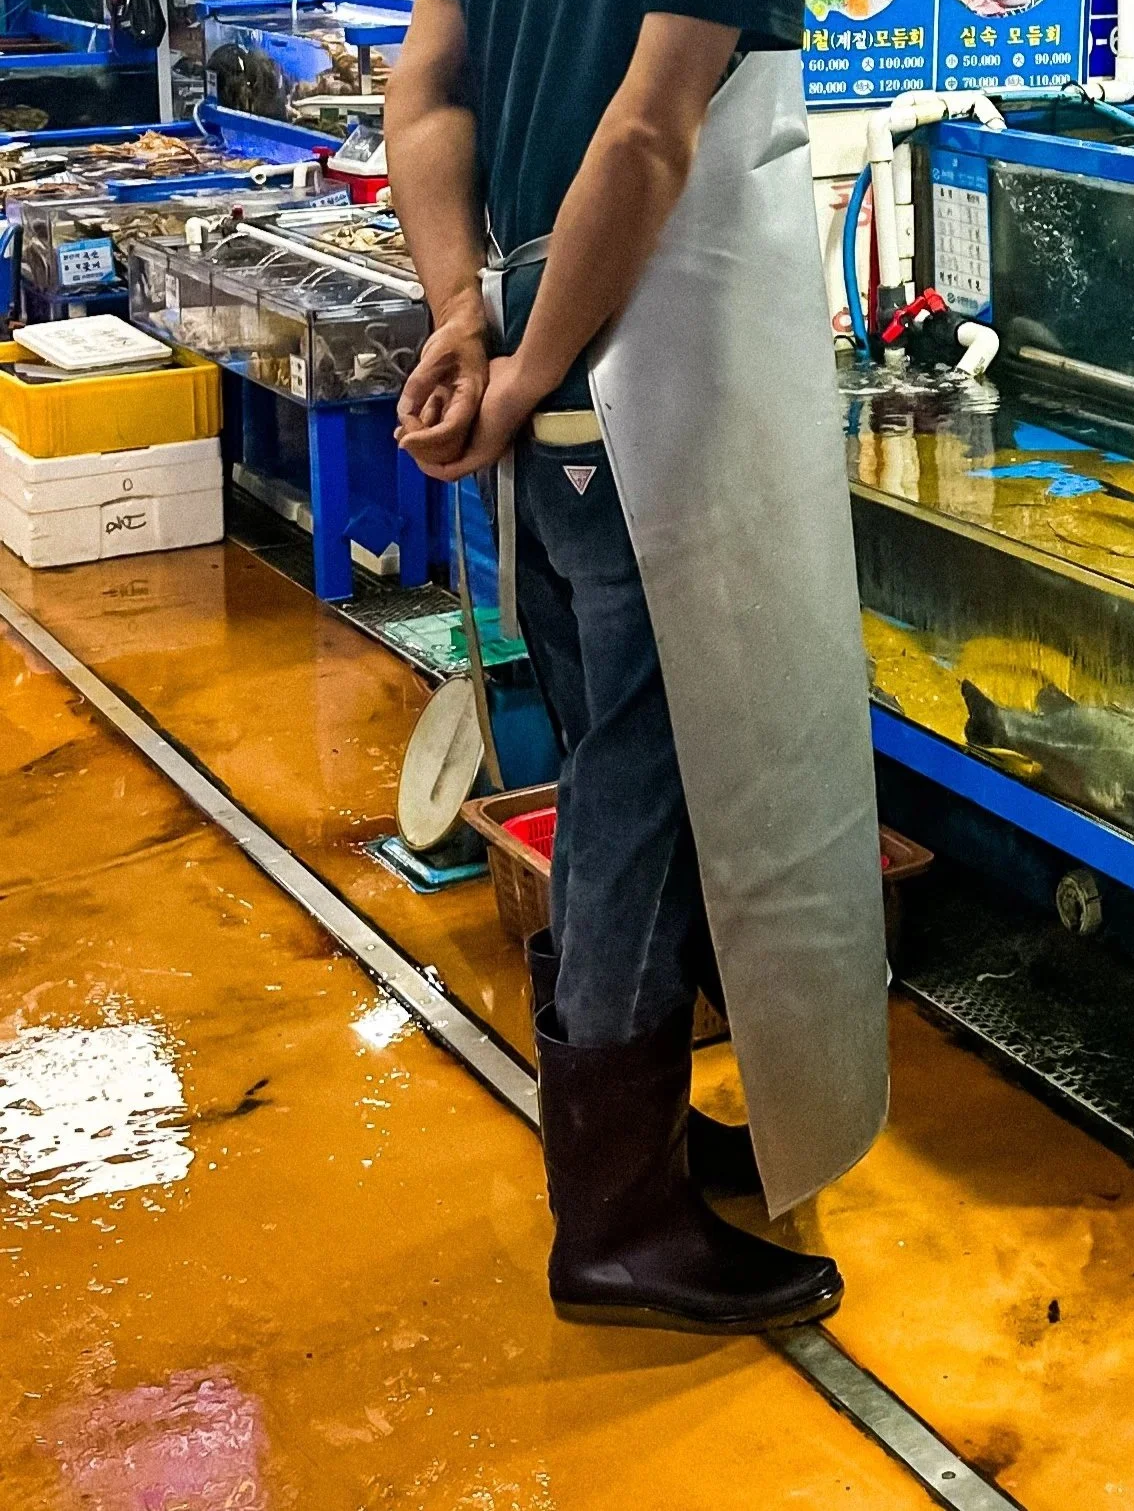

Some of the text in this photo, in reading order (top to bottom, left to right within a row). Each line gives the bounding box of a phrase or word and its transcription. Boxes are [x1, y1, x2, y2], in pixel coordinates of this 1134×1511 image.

[960, 25, 1061, 48] 실속 모듬회
[809, 59, 849, 72] 60,000
[879, 56, 924, 69] 100,000
[963, 55, 1000, 67] 50,000
[1035, 53, 1071, 65] 90,000
[809, 81, 846, 94] 80,000
[879, 79, 923, 92] 120,000
[962, 76, 998, 88] 70,000
